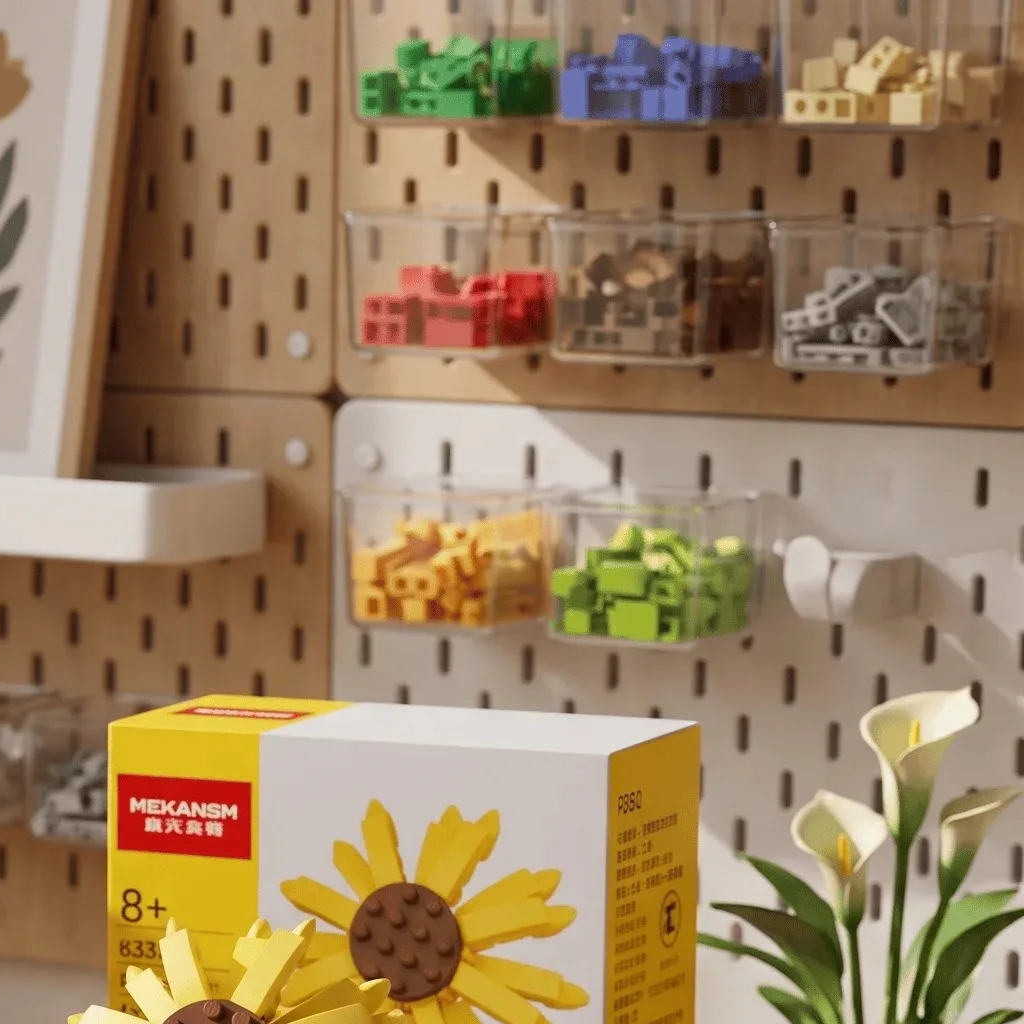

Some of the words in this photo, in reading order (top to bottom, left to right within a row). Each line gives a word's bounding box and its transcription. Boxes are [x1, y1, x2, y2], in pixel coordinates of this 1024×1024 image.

[129, 797, 238, 820] MEKANSM
[121, 888, 167, 922] 8+
[119, 939, 163, 959] 833
